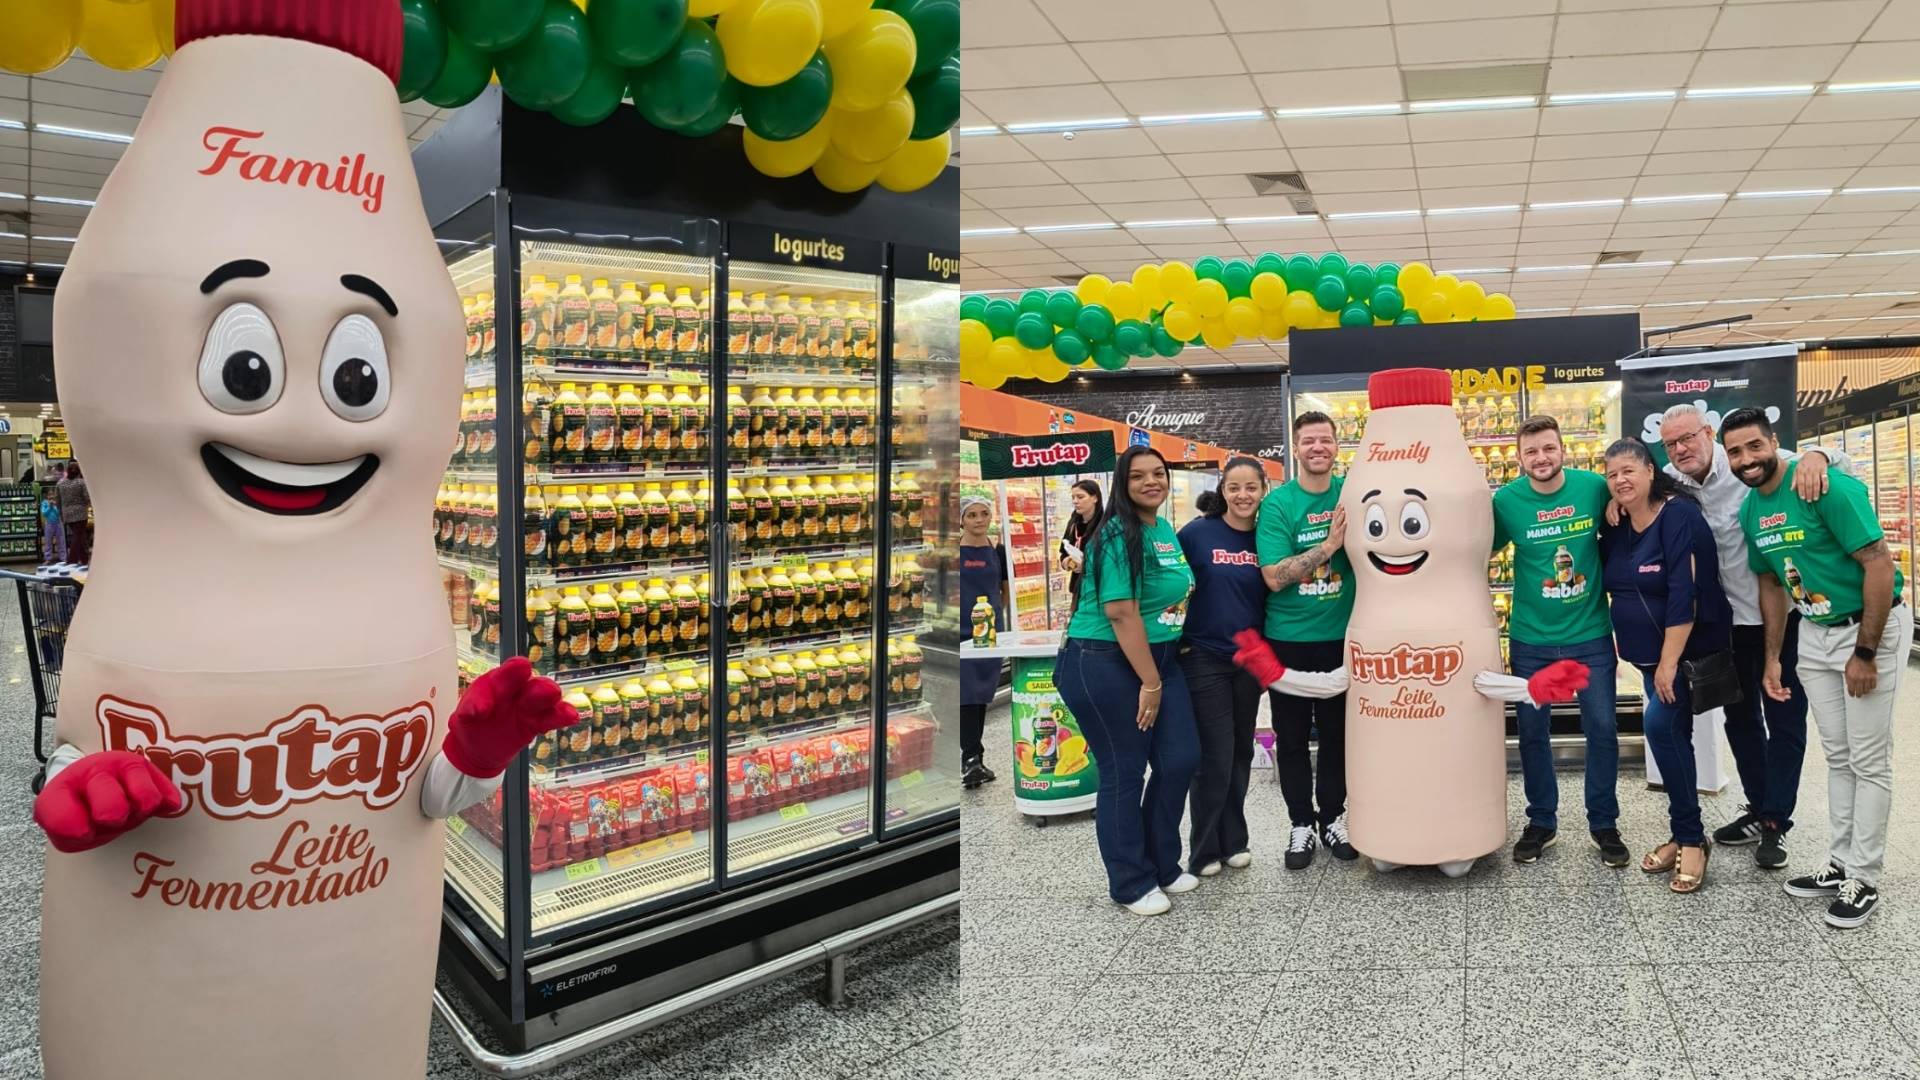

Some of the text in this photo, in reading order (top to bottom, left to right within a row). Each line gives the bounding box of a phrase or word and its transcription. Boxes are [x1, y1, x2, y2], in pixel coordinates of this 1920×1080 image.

[197, 126, 386, 214] Family
[774, 232, 846, 262] Iogurtes
[1553, 366, 1605, 381] Iogurtes
[1665, 379, 1711, 393] Frutap
[1126, 404, 1206, 432] Açougue
[1011, 443, 1090, 467] Frutap
[1366, 440, 1431, 464] Family
[1537, 505, 1575, 521] Frutap
[1212, 549, 1260, 567] Fruta
[1349, 641, 1463, 686] Frutap
[1359, 697, 1445, 719] Fermentado
[1390, 686, 1433, 706] Leite
[97, 694, 434, 820] Frutap
[250, 819, 371, 876] Leite
[131, 850, 390, 911] Fermentado
[556, 963, 617, 991] ELETROFRIO
